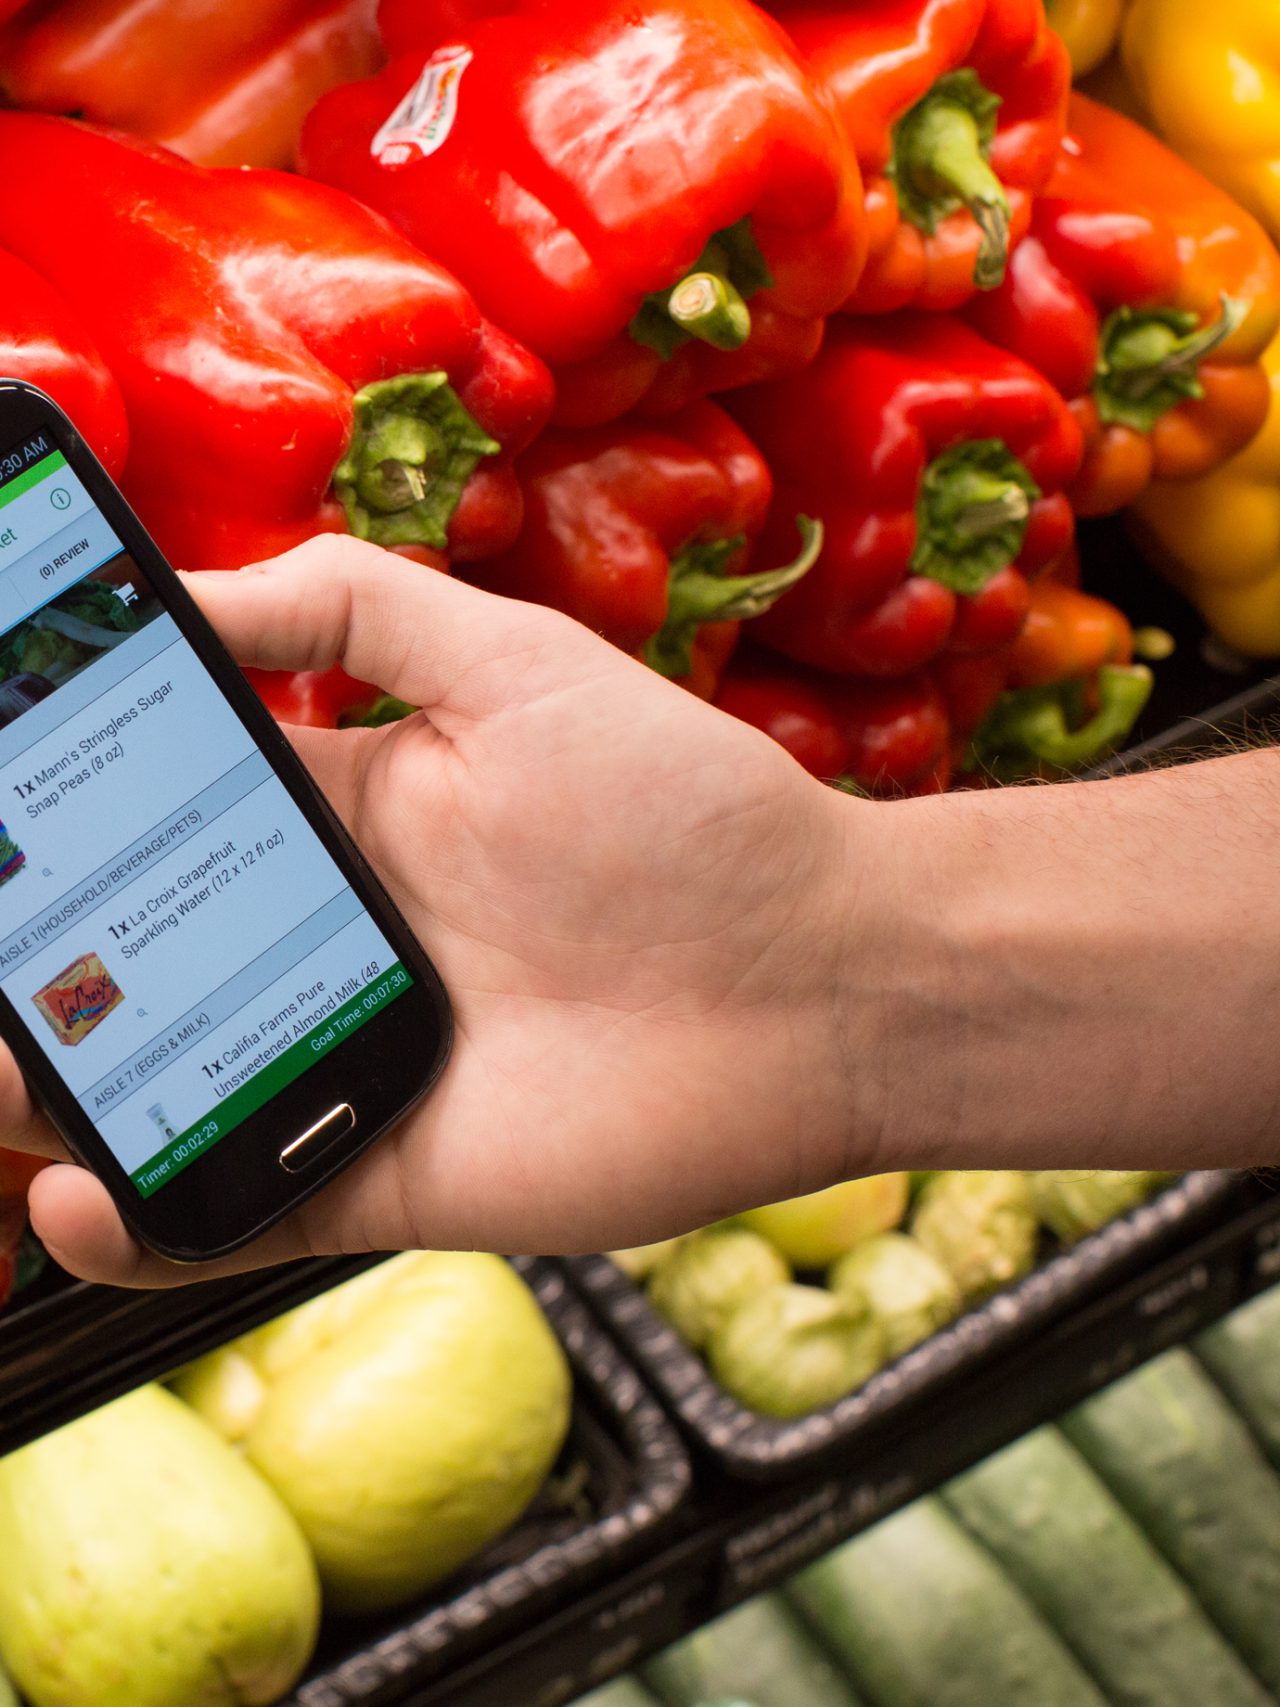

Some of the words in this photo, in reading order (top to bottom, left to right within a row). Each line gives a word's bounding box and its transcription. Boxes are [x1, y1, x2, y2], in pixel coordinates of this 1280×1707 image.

[23, 436, 48, 462] AM
[39, 564, 55, 580] (0)
[53, 538, 90, 569] REVIEW
[13, 780, 36, 799] 1x
[34, 750, 80, 787] Mann's
[78, 707, 139, 754] Stringless
[137, 681, 174, 711] Sugar
[26, 791, 60, 819] Snap
[58, 768, 91, 796] Peas
[91, 755, 104, 775] (8
[106, 741, 125, 763] oz)
[108, 920, 131, 939] 1x
[128, 910, 147, 927] La
[146, 886, 179, 913] Croix
[177, 840, 237, 890] Grapefruit
[120, 913, 179, 959] Sparkling
[175, 885, 212, 916] Water
[211, 869, 232, 893] (12
[232, 864, 241, 876] x
[240, 850, 256, 869] 12
[255, 842, 266, 858] fl
[266, 828, 285, 850] oz)
[0, 936, 32, 967] AISLE
[201, 1060, 224, 1079] 1x
[222, 1032, 261, 1065] Califia
[259, 1002, 298, 1037] Farms
[296, 981, 326, 1007] Pure
[213, 1031, 293, 1098] Unsweetened
[292, 998, 336, 1039] Almond
[335, 977, 362, 1004] Milk
[361, 961, 380, 984] (48
[310, 1028, 336, 1052] Goal
[333, 1005, 366, 1034] Time:
[362, 970, 407, 1010] 00:07:30
[94, 1077, 127, 1109] AISLE
[126, 1070, 135, 1083] 7
[135, 1044, 170, 1077] (EGGS
[168, 1038, 179, 1050] &
[177, 1012, 211, 1043] MILK)
[137, 1158, 175, 1189] Timer:
[172, 1120, 219, 1162] 00:02:29
